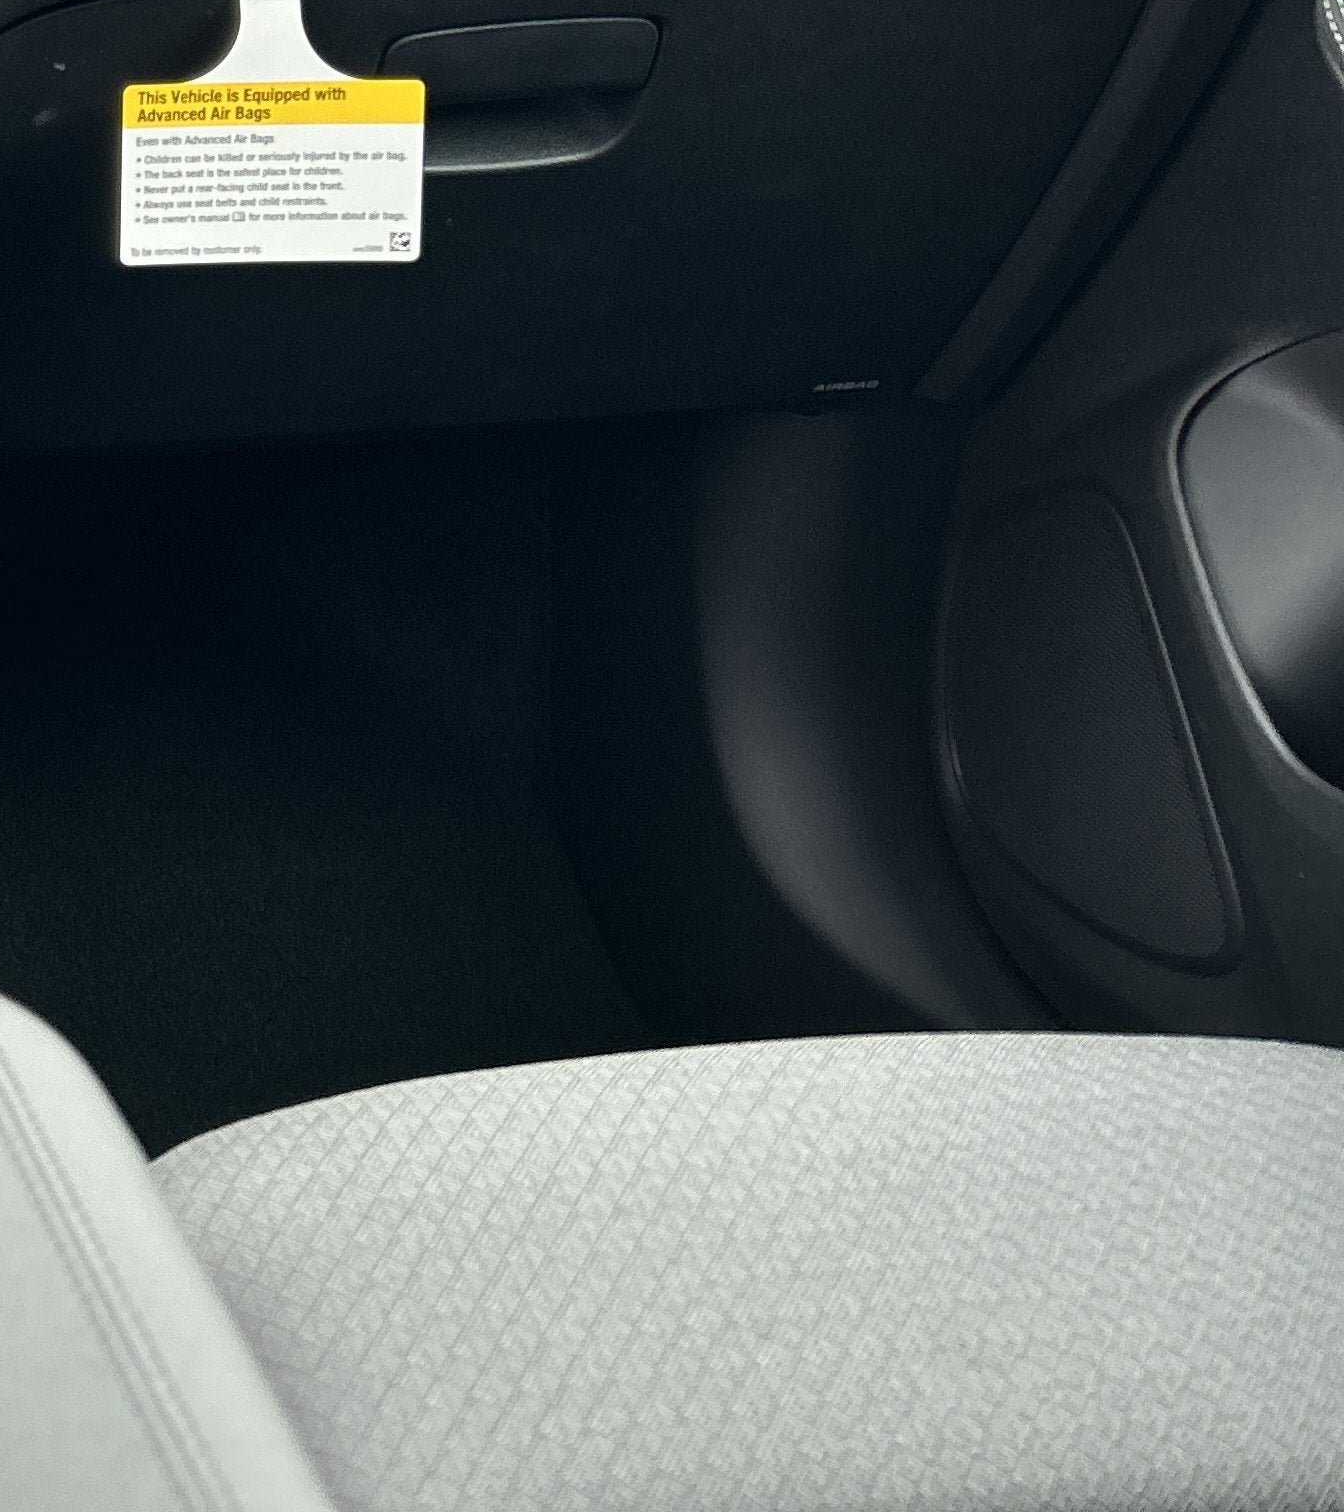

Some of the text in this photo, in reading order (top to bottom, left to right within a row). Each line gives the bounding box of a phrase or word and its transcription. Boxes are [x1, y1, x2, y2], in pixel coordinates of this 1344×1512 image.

[138, 87, 347, 106] This Vehicle is Equipped with
[137, 105, 272, 123] Advanced Air Bags
[136, 133, 274, 147] Even with Advanced Air Bags
[144, 155, 182, 164] Children
[184, 155, 201, 163] can
[204, 153, 215, 163] be
[218, 153, 243, 162] killed
[246, 154, 255, 162] or
[258, 152, 300, 163] seriously
[303, 152, 336, 162] injured
[339, 151, 350, 163] by
[353, 151, 368, 160] the
[371, 151, 384, 160] air
[144, 167, 343, 179] The back seat is the safest place for children.
[144, 185, 168, 194] Never
[171, 185, 185, 195] put
[195, 183, 244, 194] rear-facing
[247, 183, 268, 192] child
[271, 182, 290, 191] seat
[303, 182, 317, 191] the
[143, 200, 174, 210] Always
[176, 200, 192, 208] use
[195, 199, 213, 208] seat
[215, 199, 237, 207] belts
[239, 198, 256, 207] and
[258, 197, 280, 206] child
[143, 215, 159, 224] See
[162, 214, 195, 224] owner's
[198, 213, 229, 222] manual
[248, 212, 260, 221] for
[263, 213, 285, 221] more
[288, 212, 338, 221] information
[341, 211, 366, 220] about
[368, 211, 380, 220] air
[141, 248, 151, 257] be
[154, 247, 189, 256] removed
[191, 247, 200, 257] by
[203, 246, 240, 255] customer
